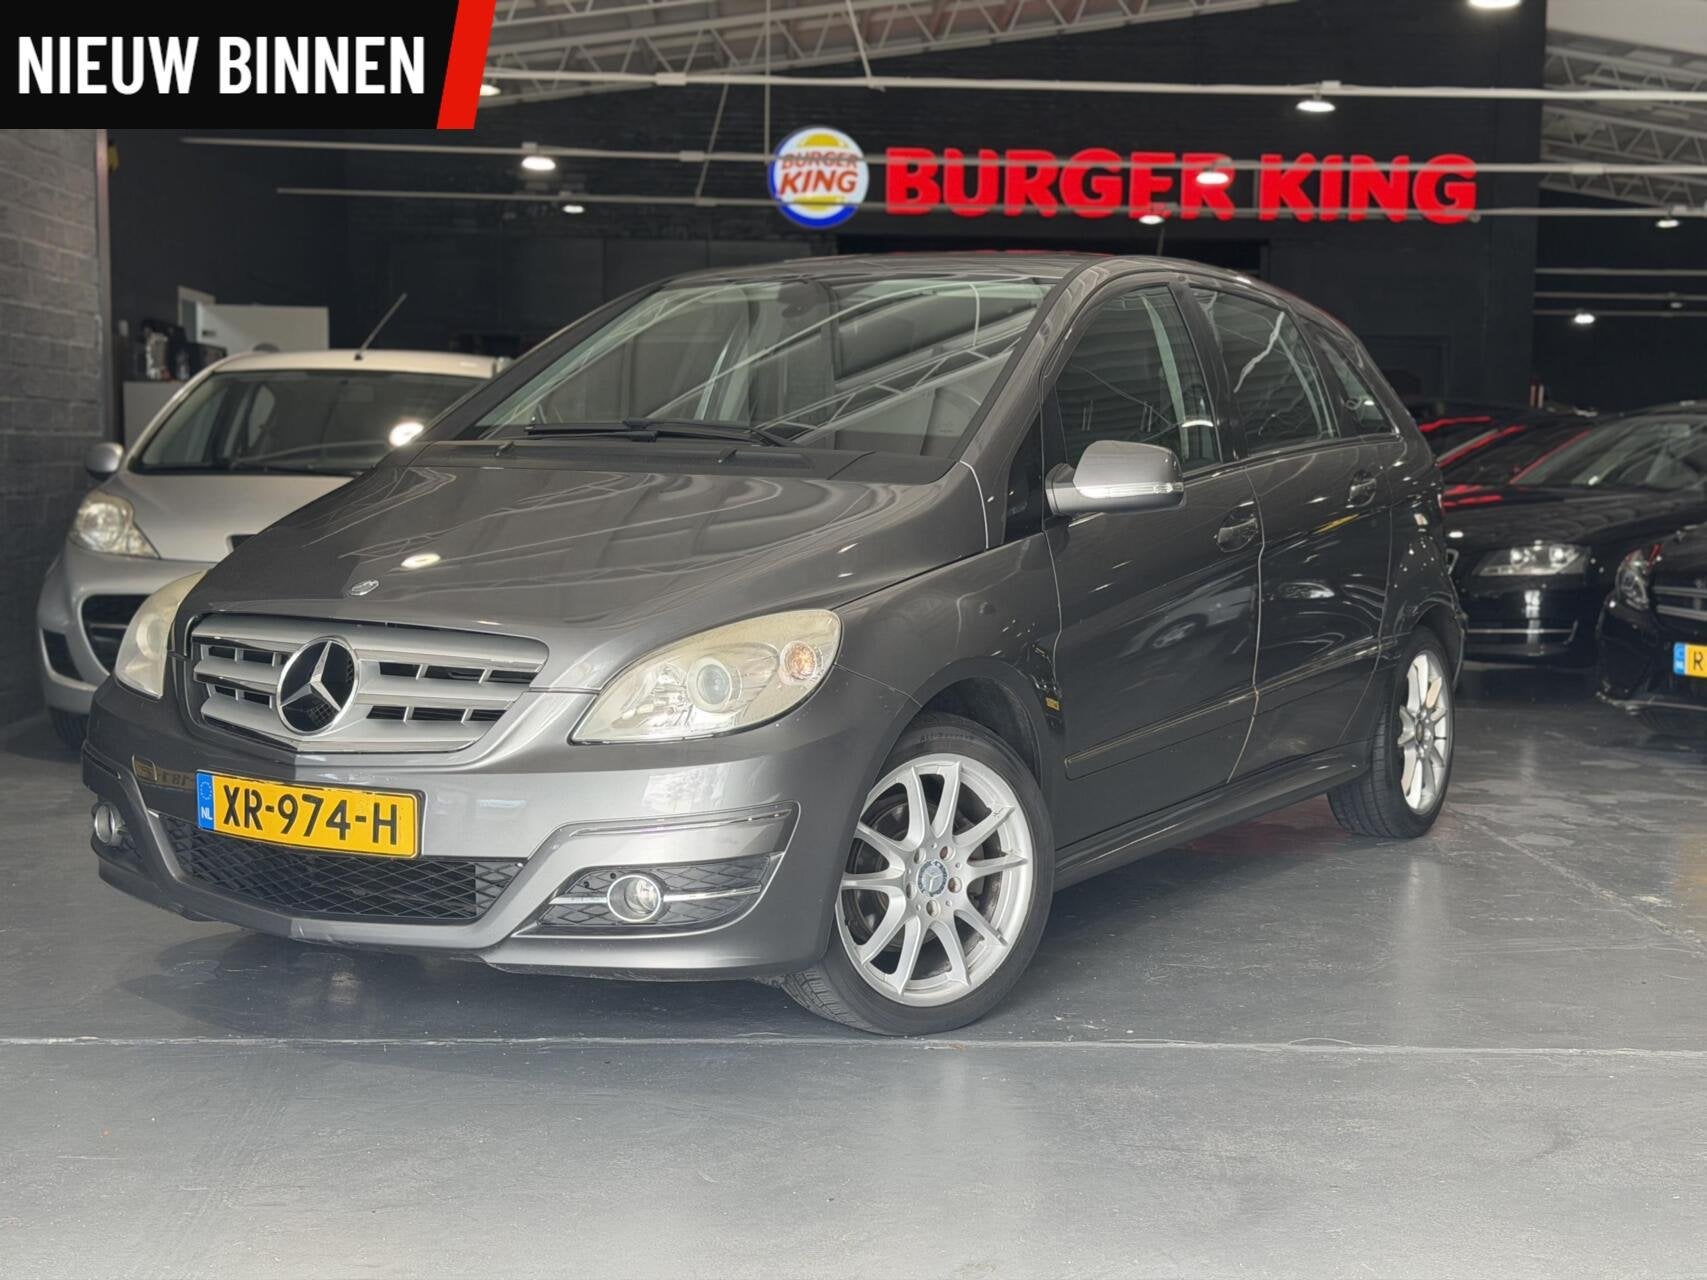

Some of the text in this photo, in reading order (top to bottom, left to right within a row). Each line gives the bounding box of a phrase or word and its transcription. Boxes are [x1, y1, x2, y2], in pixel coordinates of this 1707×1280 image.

[782, 150, 859, 170] BURGER
[780, 169, 858, 195] KING
[885, 147, 1478, 225] BURGER KING
[201, 806, 213, 821] NL
[223, 784, 398, 845] XR-974-H
